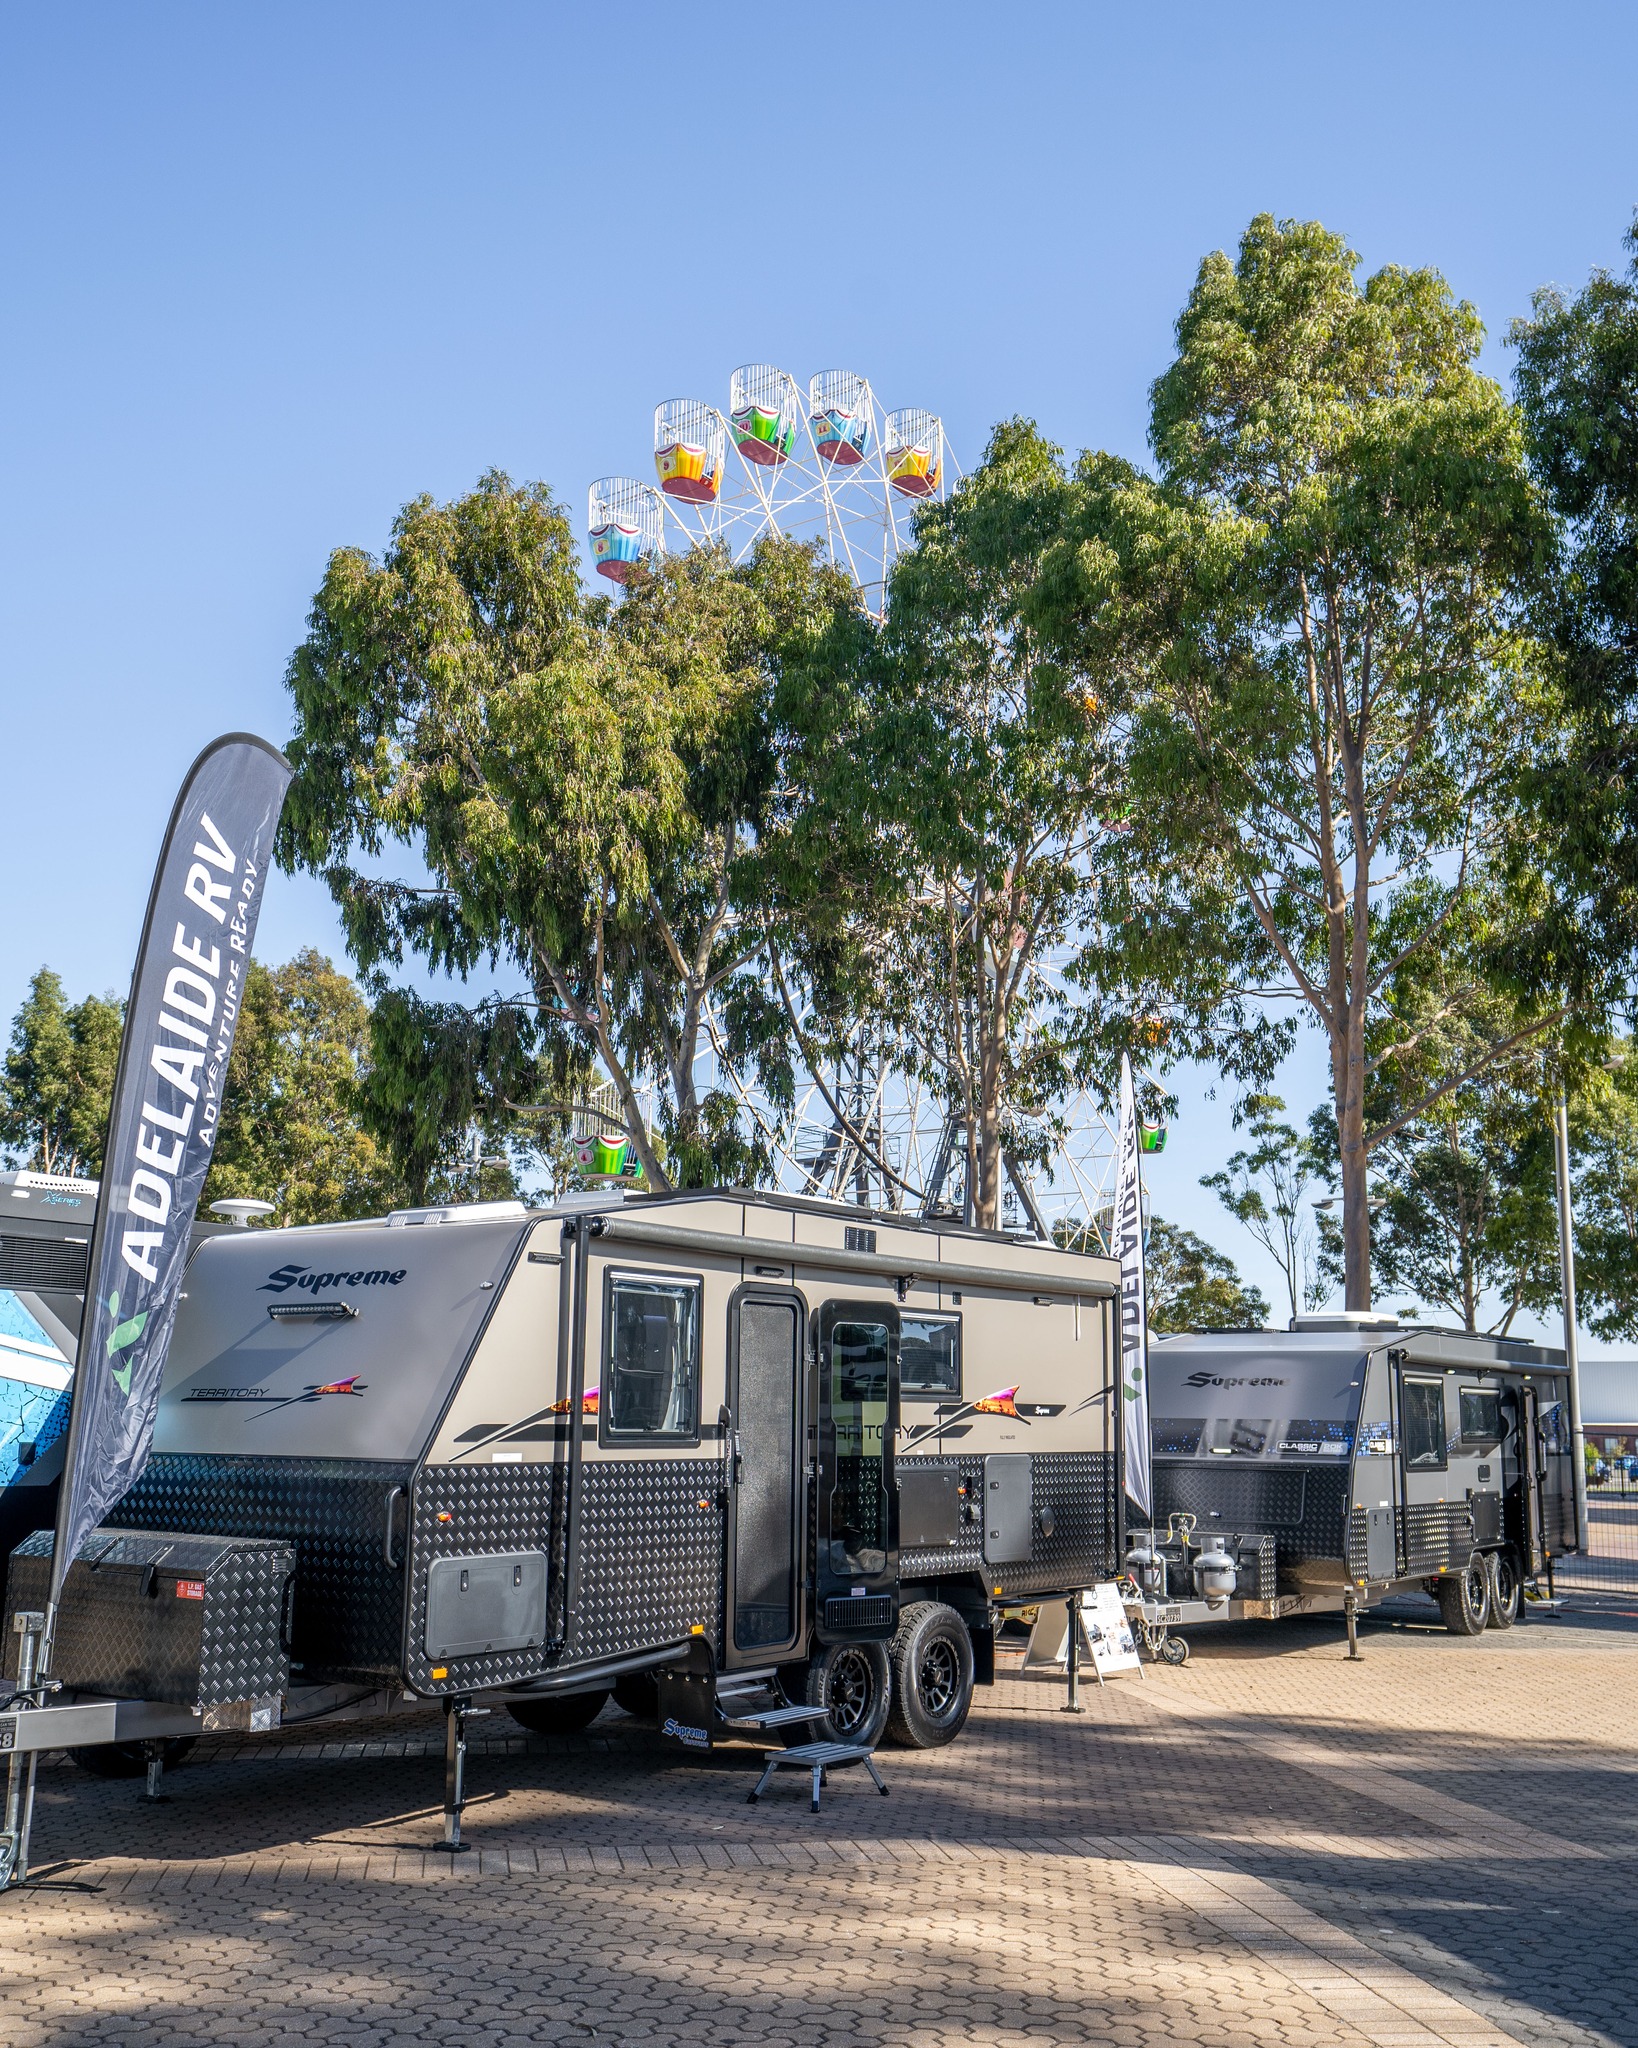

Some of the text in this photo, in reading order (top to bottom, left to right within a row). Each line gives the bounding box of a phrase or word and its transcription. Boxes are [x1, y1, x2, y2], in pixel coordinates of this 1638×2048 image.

[199, 859, 257, 1148] ADVENTURE READY
[121, 812, 236, 1284] ADELAIDE RV
[256, 1265, 407, 1295] Supreme
[191, 1389, 270, 1397] TERRITORY
[1181, 1372, 1289, 1390] Supreme
[662, 1718, 708, 1740] Supreme
